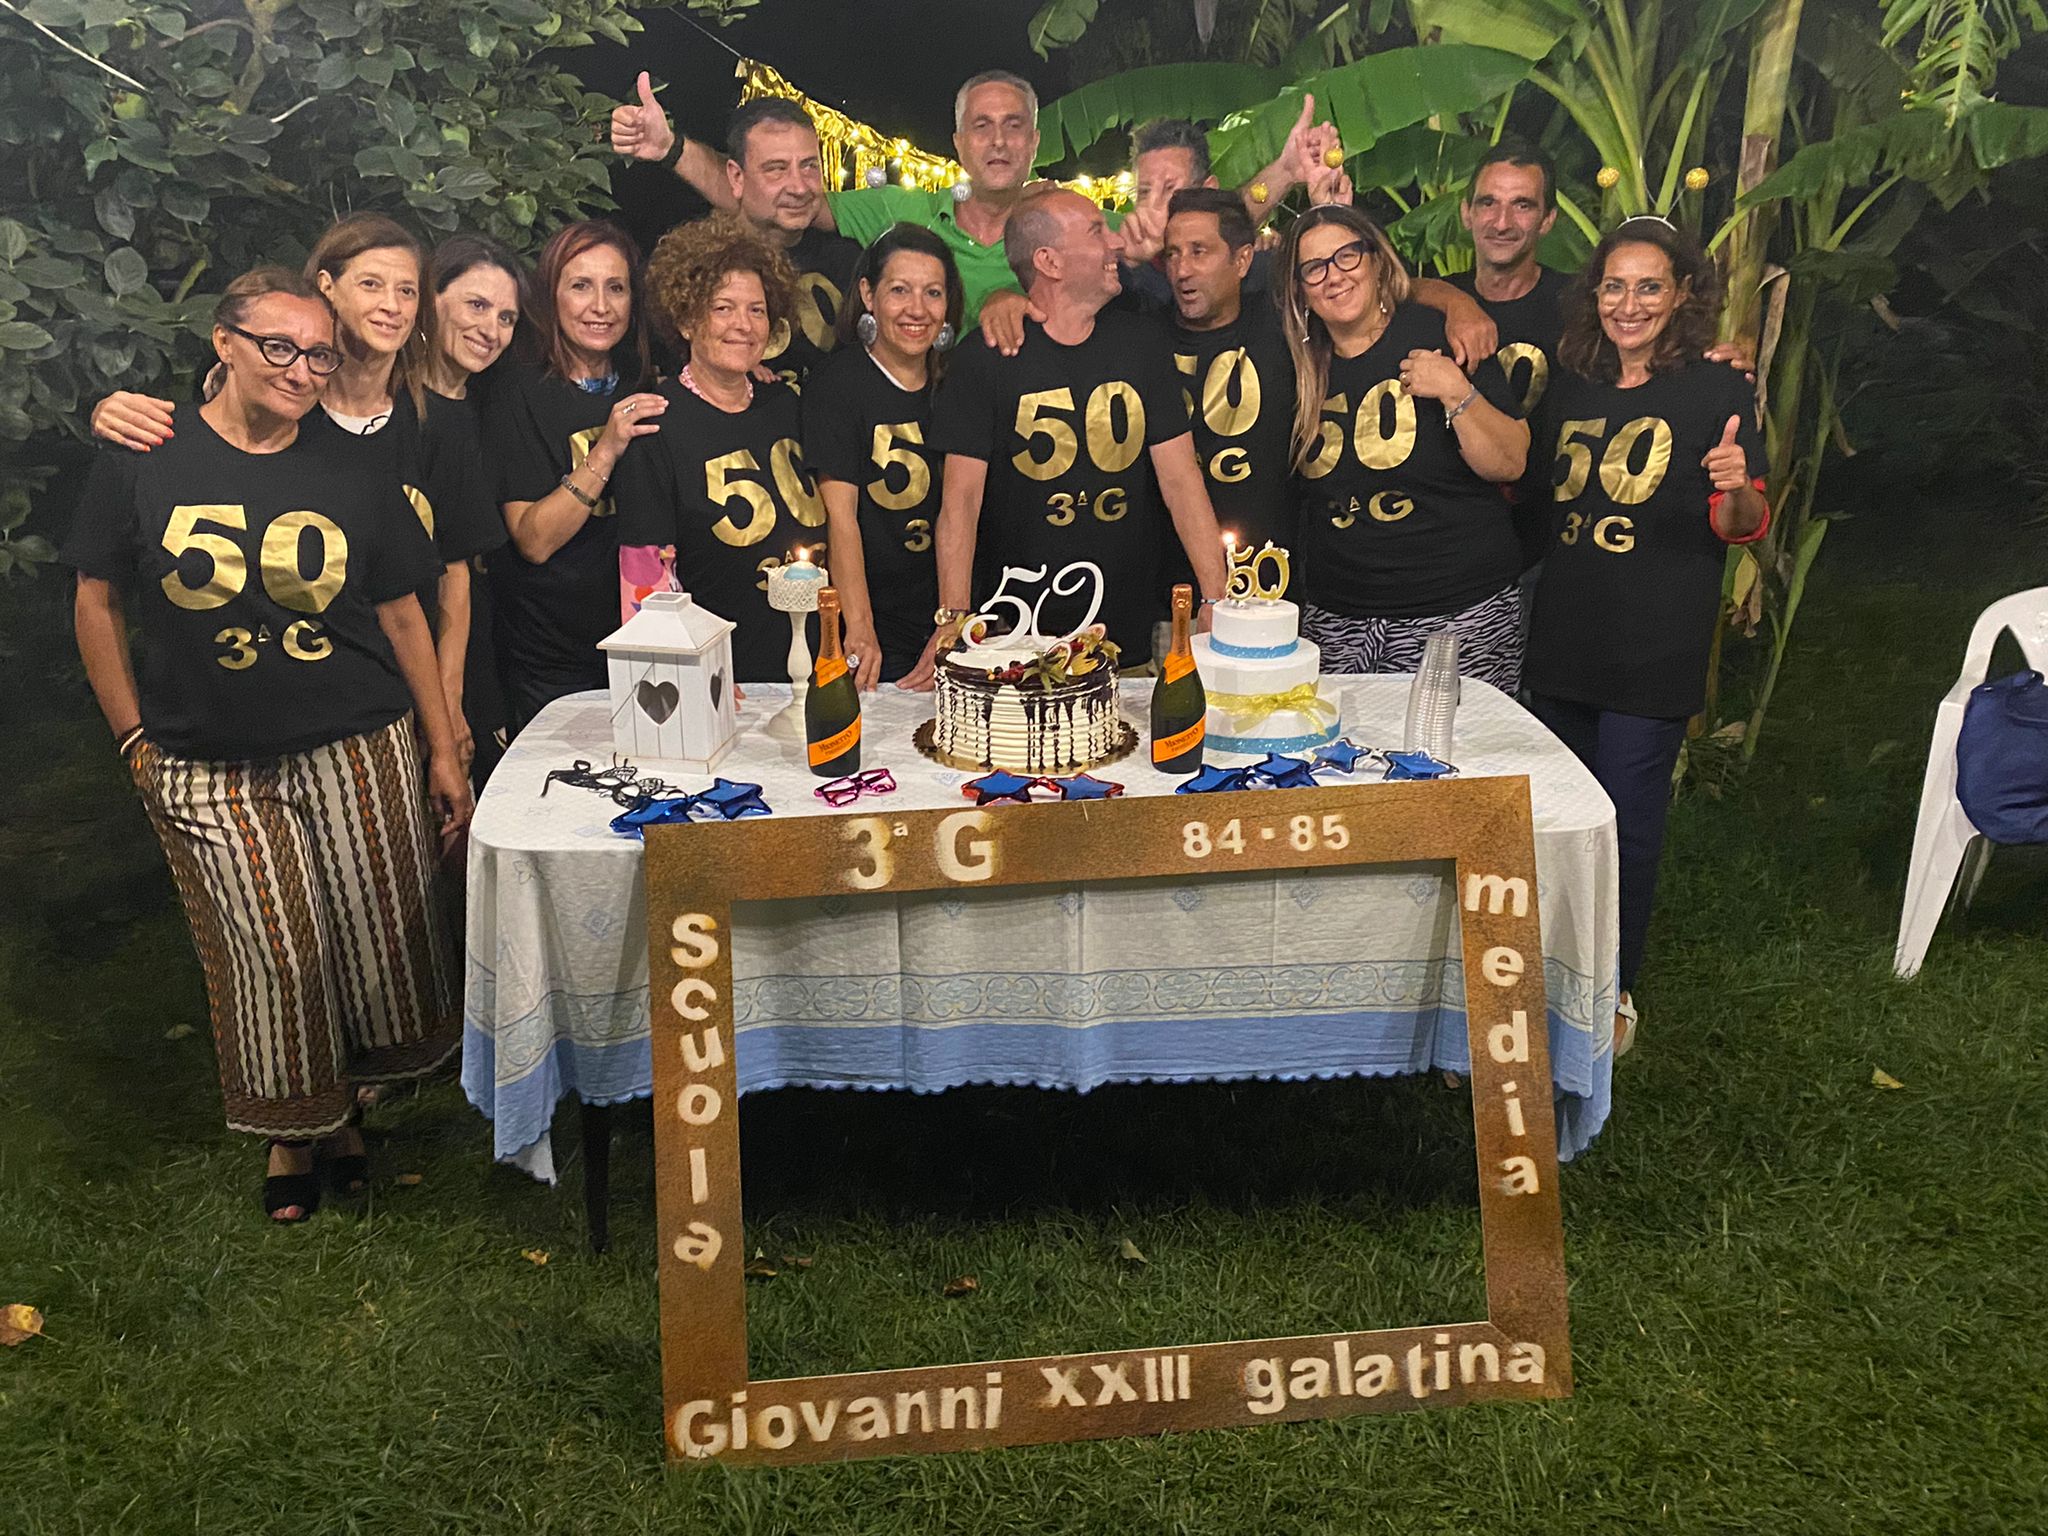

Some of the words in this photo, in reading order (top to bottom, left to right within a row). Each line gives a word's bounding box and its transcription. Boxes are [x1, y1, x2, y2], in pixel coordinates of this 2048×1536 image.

[1011, 380, 1146, 481] 50
[1209, 447, 1252, 483] G
[1553, 416, 1673, 505] 50
[705, 438, 827, 547] 50
[161, 504, 348, 614] 50
[961, 561, 1104, 650] 50
[1226, 545, 1290, 601] 50
[937, 810, 999, 882] G
[1464, 873, 1541, 1196] media
[671, 913, 726, 1272] Scuola
[672, 1371, 1003, 1458] Giovanni
[1244, 1333, 1546, 1415] galatina
